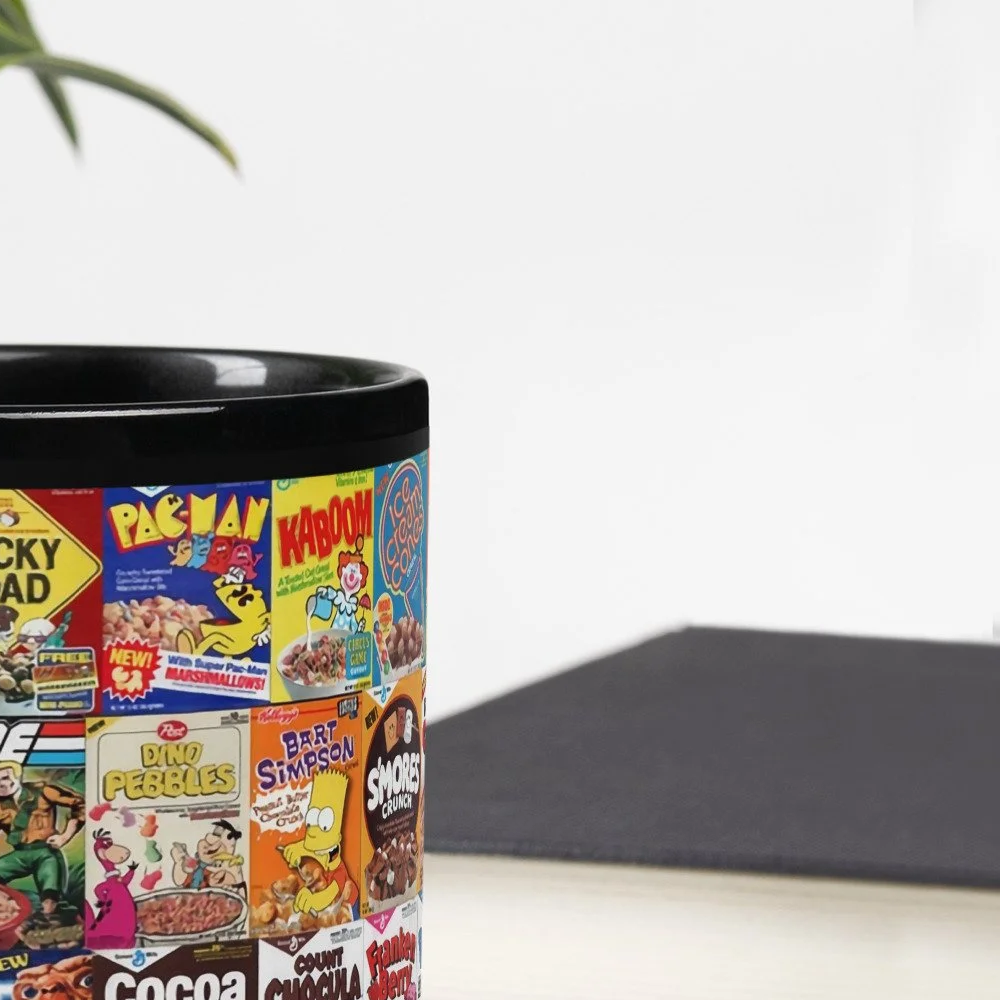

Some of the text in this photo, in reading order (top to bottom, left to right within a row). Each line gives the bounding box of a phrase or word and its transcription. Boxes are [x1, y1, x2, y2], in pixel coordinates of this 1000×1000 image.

[276, 488, 373, 569] KABOOM
[109, 648, 153, 668] NEW!
[168, 655, 267, 676] With Super Pac-Man
[165, 667, 265, 690] MARSHMALLOWS!
[141, 742, 204, 768] DINO
[281, 720, 338, 760] BART
[256, 736, 354, 791] SIMPSON
[103, 763, 236, 800] PEBBLES
[367, 752, 420, 812] S'MORES
[382, 793, 413, 819] CRUNCH
[294, 946, 343, 977] COUNT
